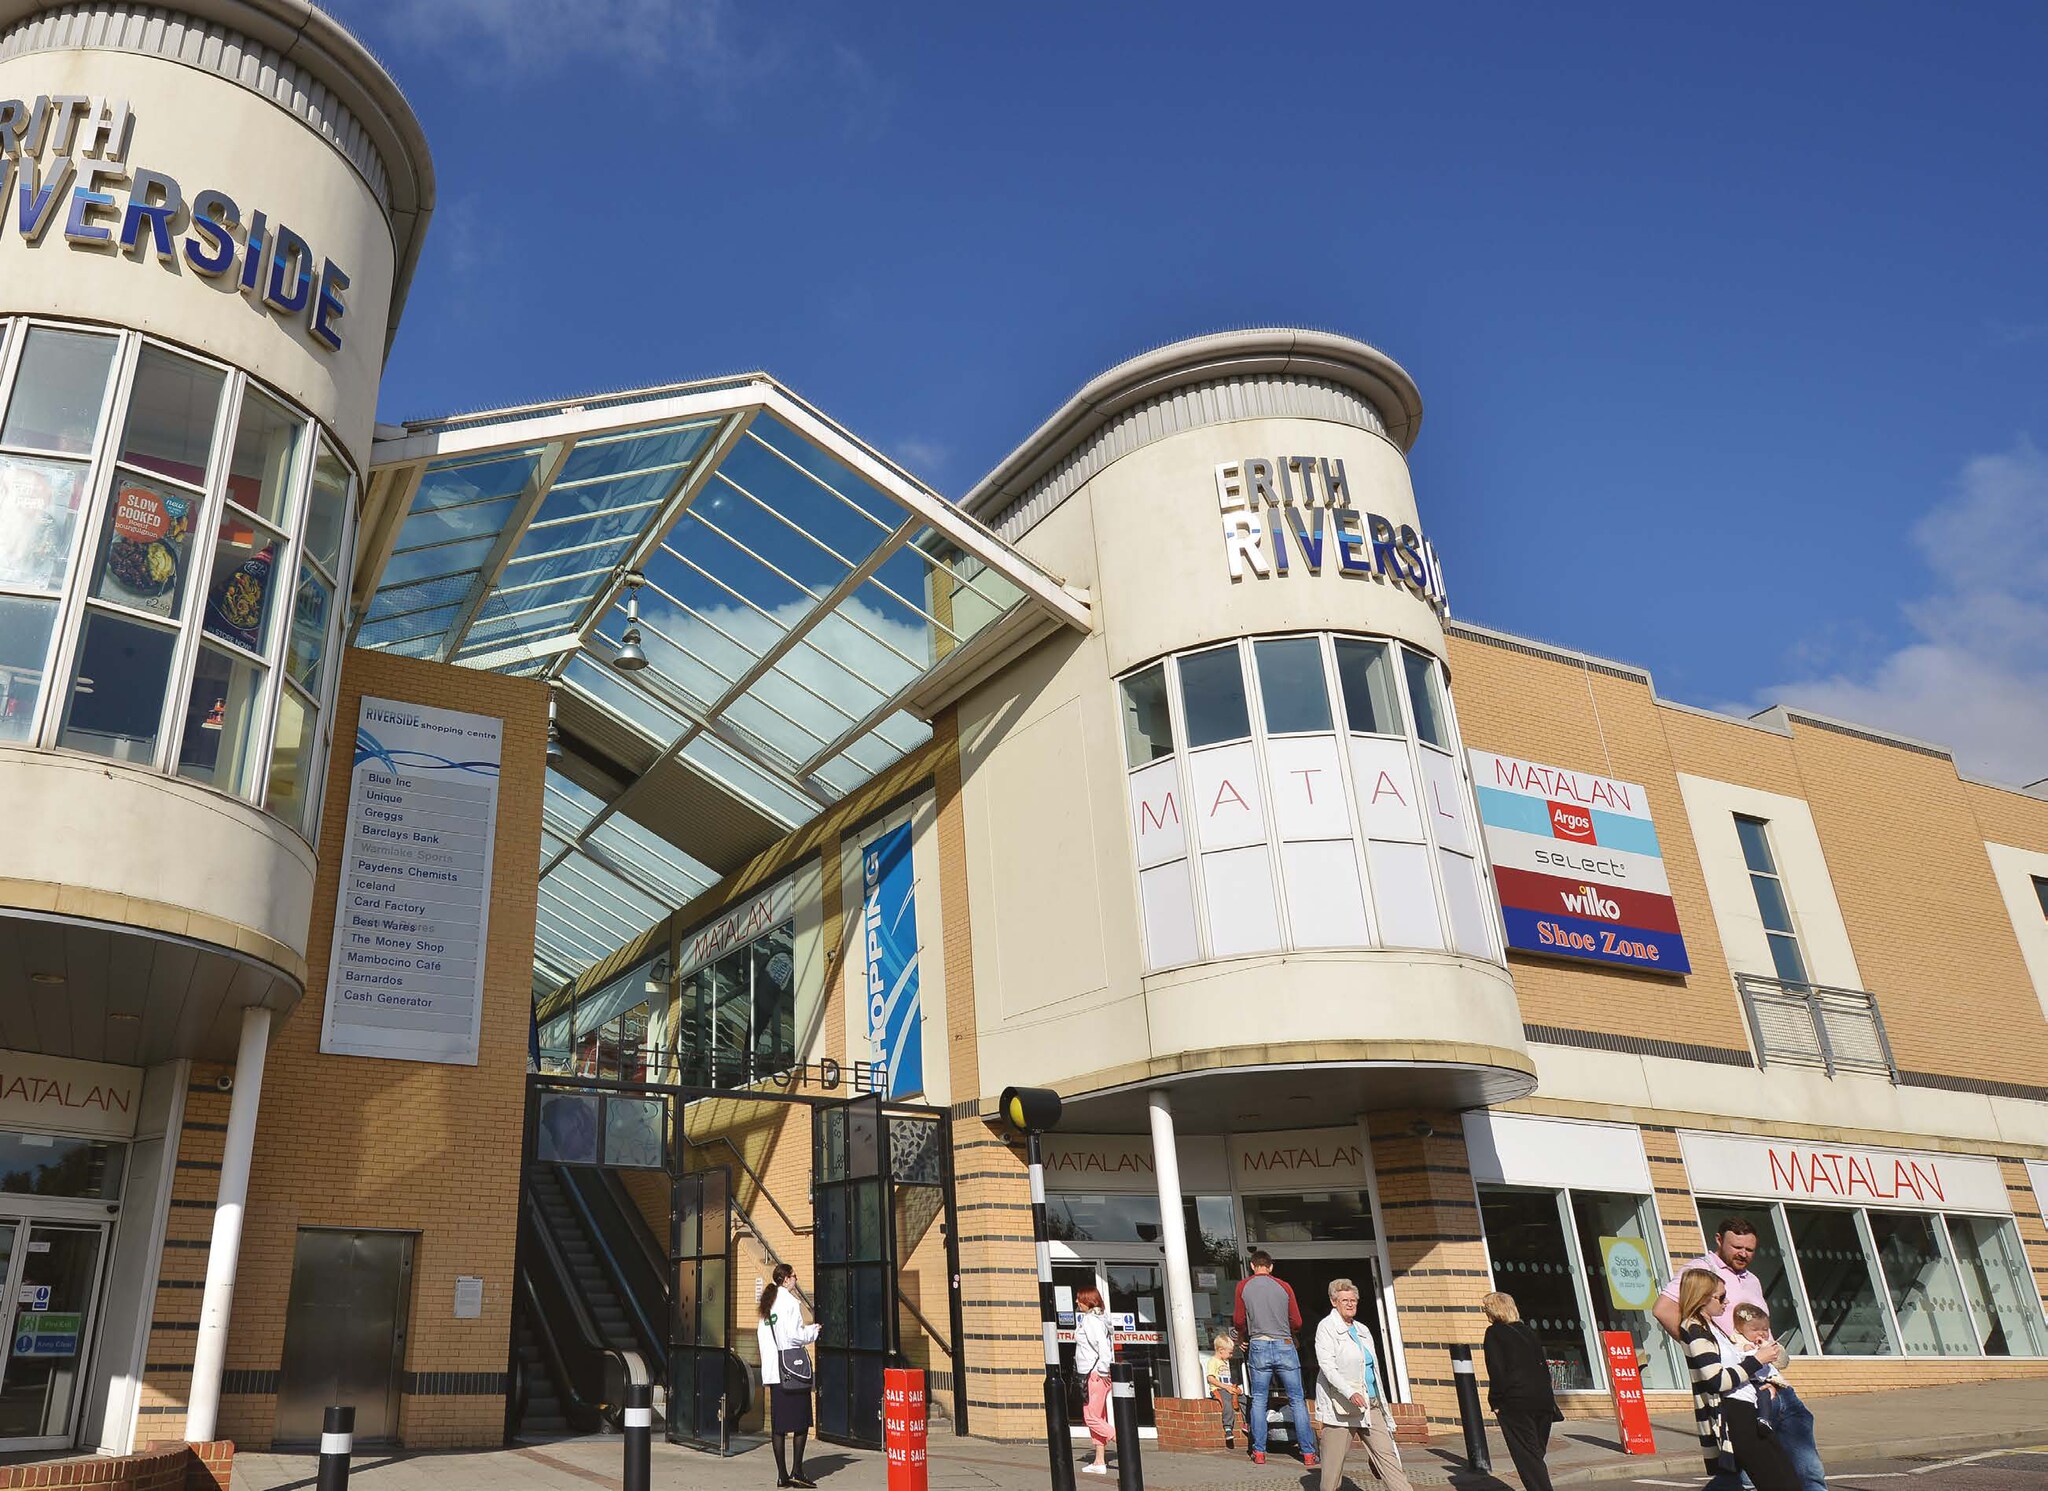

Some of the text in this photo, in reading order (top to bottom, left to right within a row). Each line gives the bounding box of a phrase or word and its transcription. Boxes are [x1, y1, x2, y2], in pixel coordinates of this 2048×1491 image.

[1214, 456, 1350, 509] ERITH
[127, 495, 158, 513] SLOW
[118, 505, 161, 527] COOKED
[366, 707, 497, 740] RIVERSIDE shopping centre
[368, 773, 412, 788] Blue Inc
[1495, 758, 1631, 811] MATALAN
[366, 790, 403, 804] Unique
[364, 807, 404, 822] Greggs
[1554, 809, 1590, 829] Argos
[362, 824, 440, 845] Barclays Bank
[417, 850, 454, 864] Sports
[357, 860, 458, 882] Paydens Chemists
[356, 879, 396, 893] Iceland
[354, 896, 426, 915] Card Factory
[1560, 885, 1620, 920] wilko
[352, 916, 417, 932] Best Wares
[693, 893, 774, 965] MATALAN
[351, 933, 445, 953] The Money Shop
[1537, 920, 1660, 961] Shoe Zone
[347, 952, 441, 971] Mambocino Café
[345, 971, 403, 986] Barnardos
[865, 851, 888, 1100] SHOPPING
[344, 990, 433, 1008] Cash Generator
[0, 1075, 131, 1113] ATALAN
[1769, 1149, 1945, 1202] MATALAN
[1614, 1256, 1639, 1267] School
[1114, 1333, 1163, 1342] ENTRANCE
[1610, 1346, 1632, 1356] SALE
[1615, 1368, 1636, 1378] SALE
[886, 1388, 904, 1402] SALE
[908, 1390, 923, 1403] SALE
[1619, 1390, 1641, 1399] SALE
[887, 1418, 905, 1432] SALE
[909, 1419, 924, 1432] SALE
[888, 1447, 906, 1461] SALE
[910, 1448, 925, 1462] SALE
